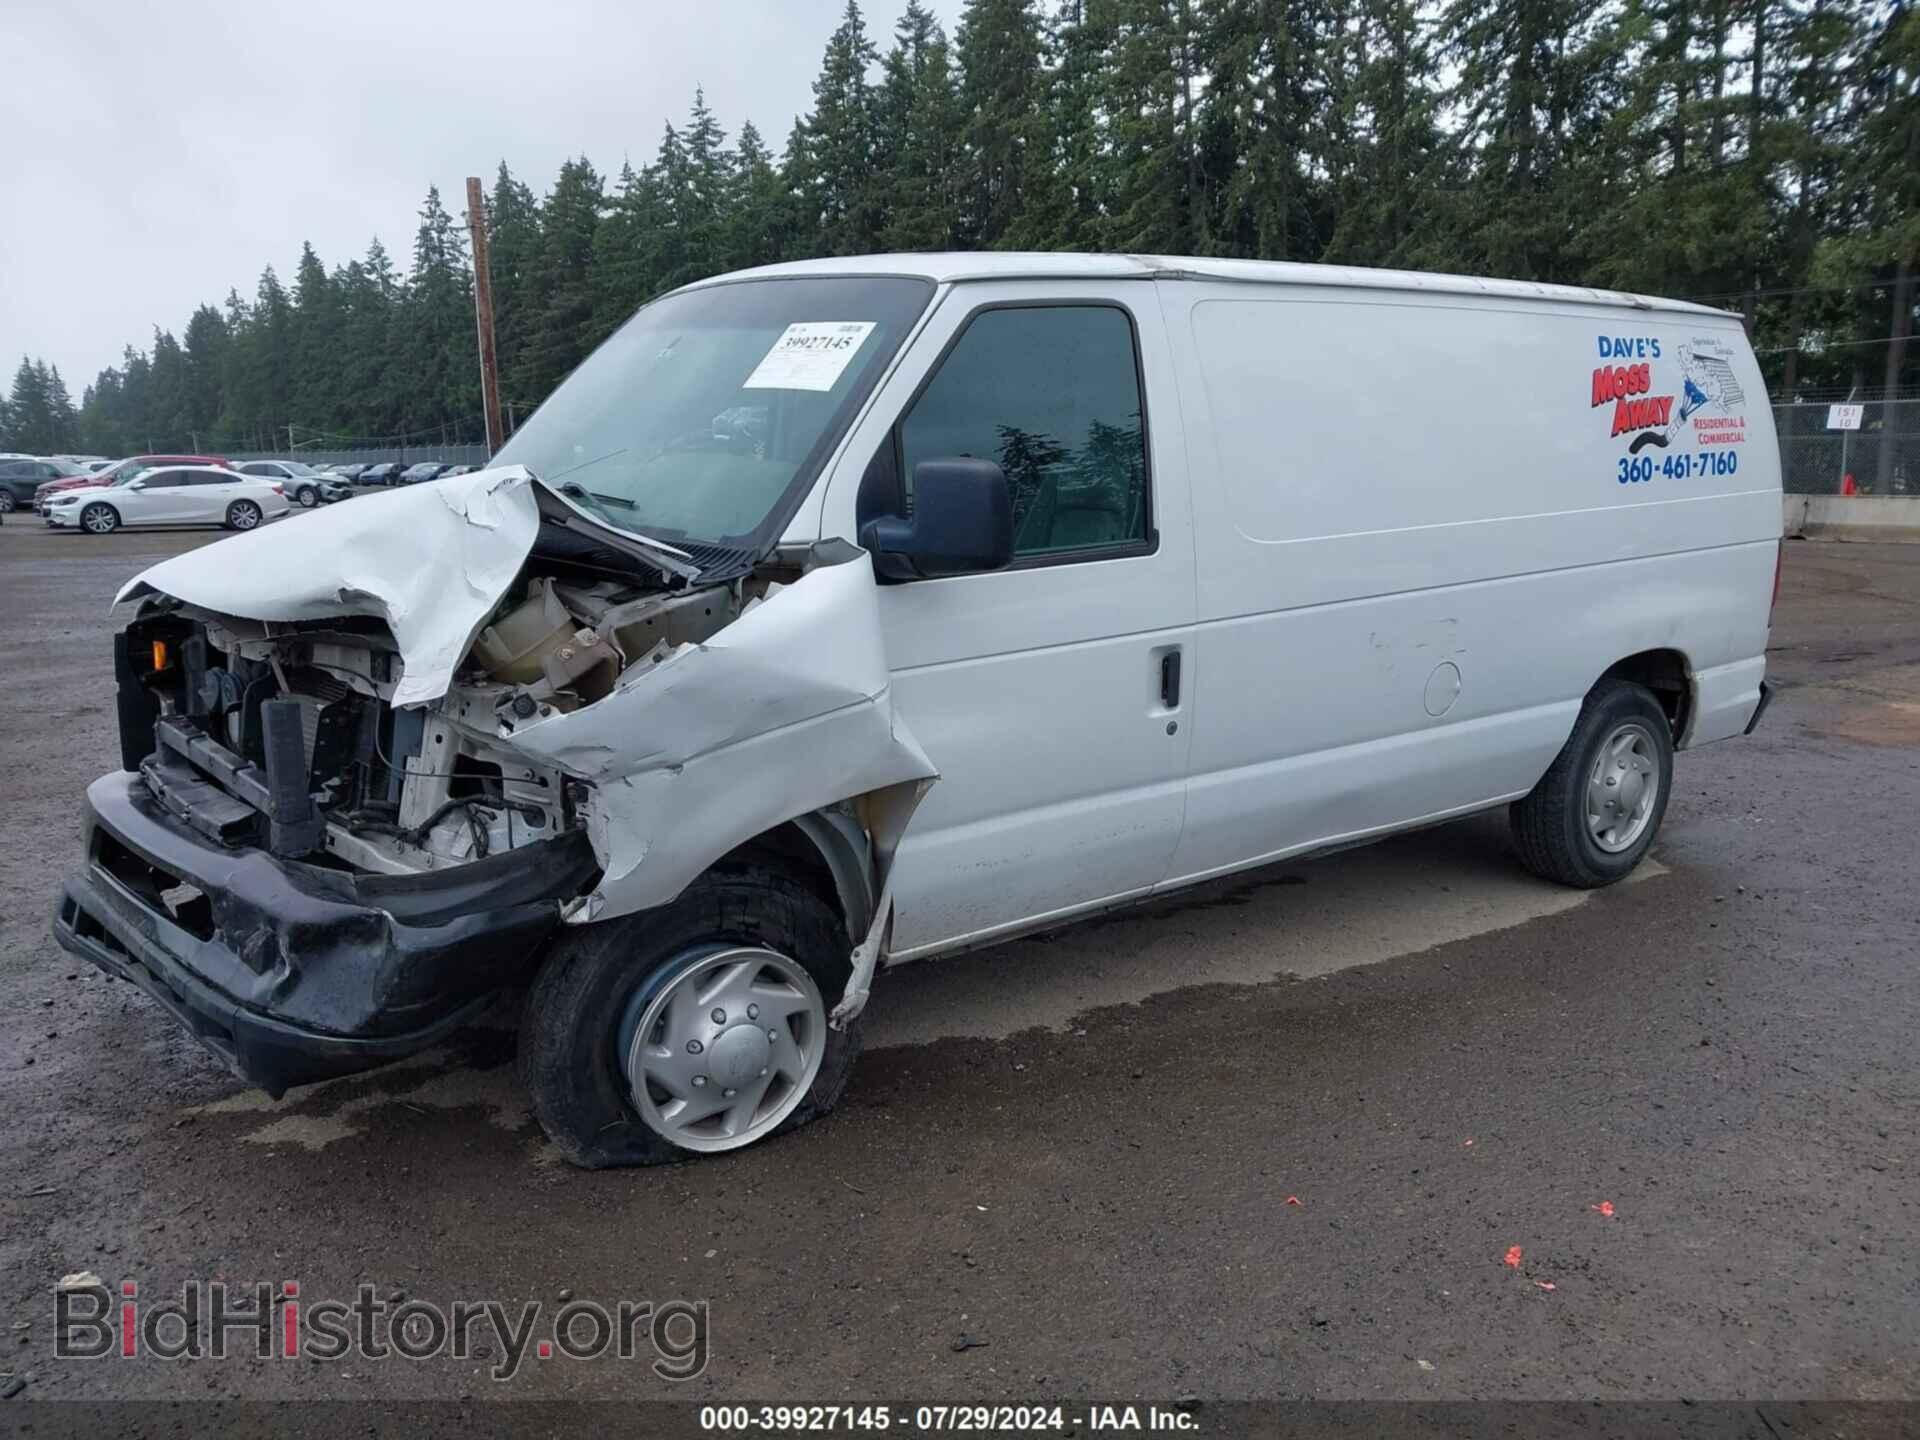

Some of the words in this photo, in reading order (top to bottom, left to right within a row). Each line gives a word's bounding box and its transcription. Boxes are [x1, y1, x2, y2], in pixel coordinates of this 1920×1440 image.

[1598, 335, 1661, 358] DAVE'S
[1591, 363, 1650, 408] MOSS
[1611, 396, 1674, 438] AWAY
[1693, 418, 1738, 429] RESIDENTIAL
[1698, 432, 1745, 445] COMMERCIAL
